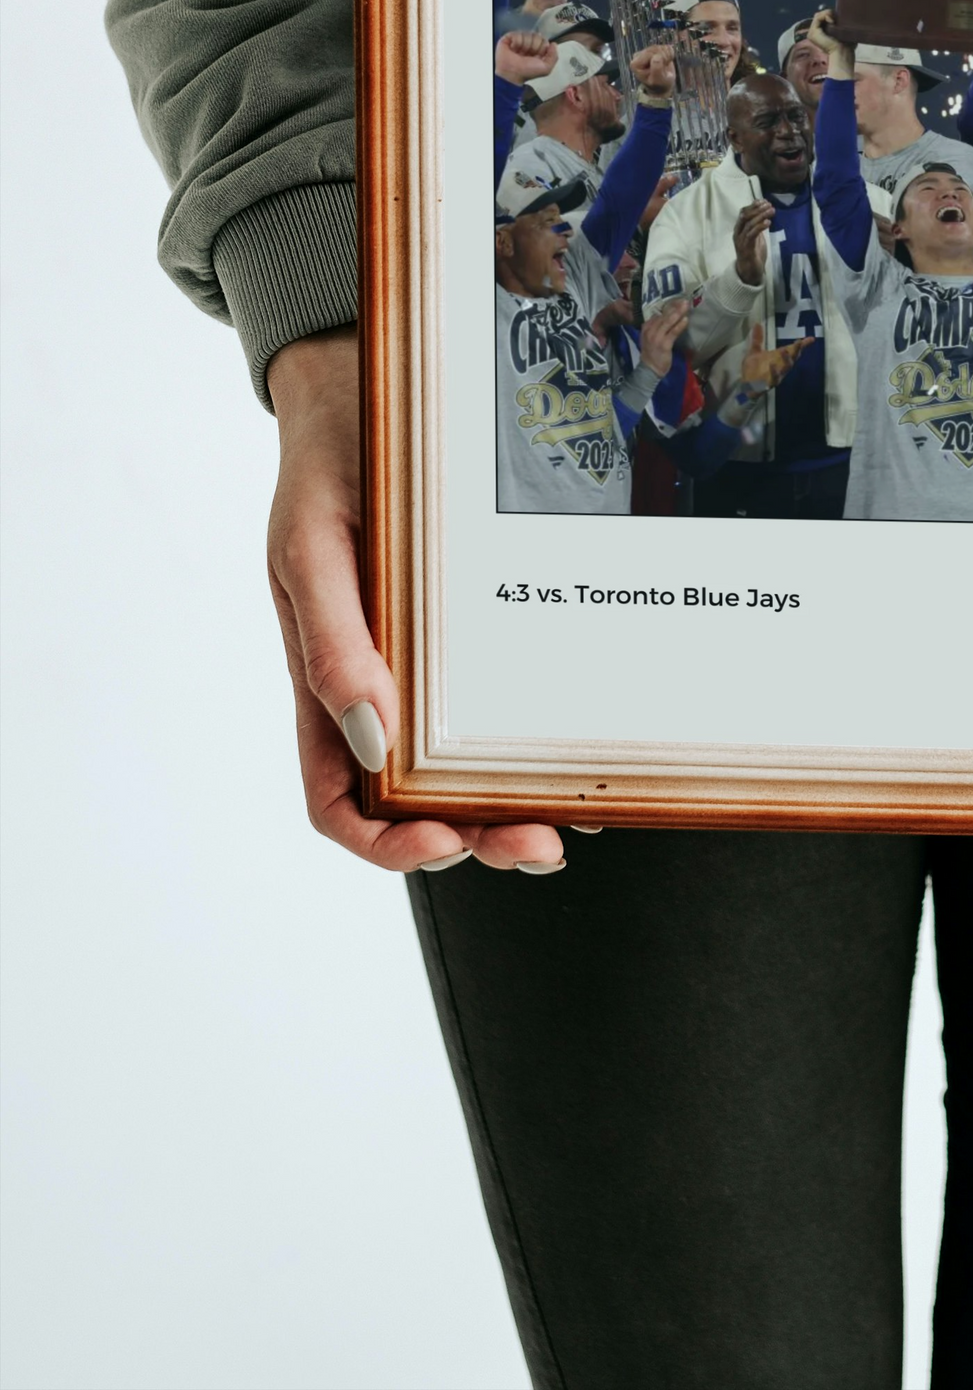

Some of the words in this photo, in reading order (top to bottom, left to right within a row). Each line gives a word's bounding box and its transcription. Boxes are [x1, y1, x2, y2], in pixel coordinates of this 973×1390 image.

[495, 583, 530, 603] 4:3
[536, 588, 568, 604] vs.
[574, 584, 676, 606] Toronto
[683, 586, 740, 607] Blue
[746, 588, 801, 613] Jays
